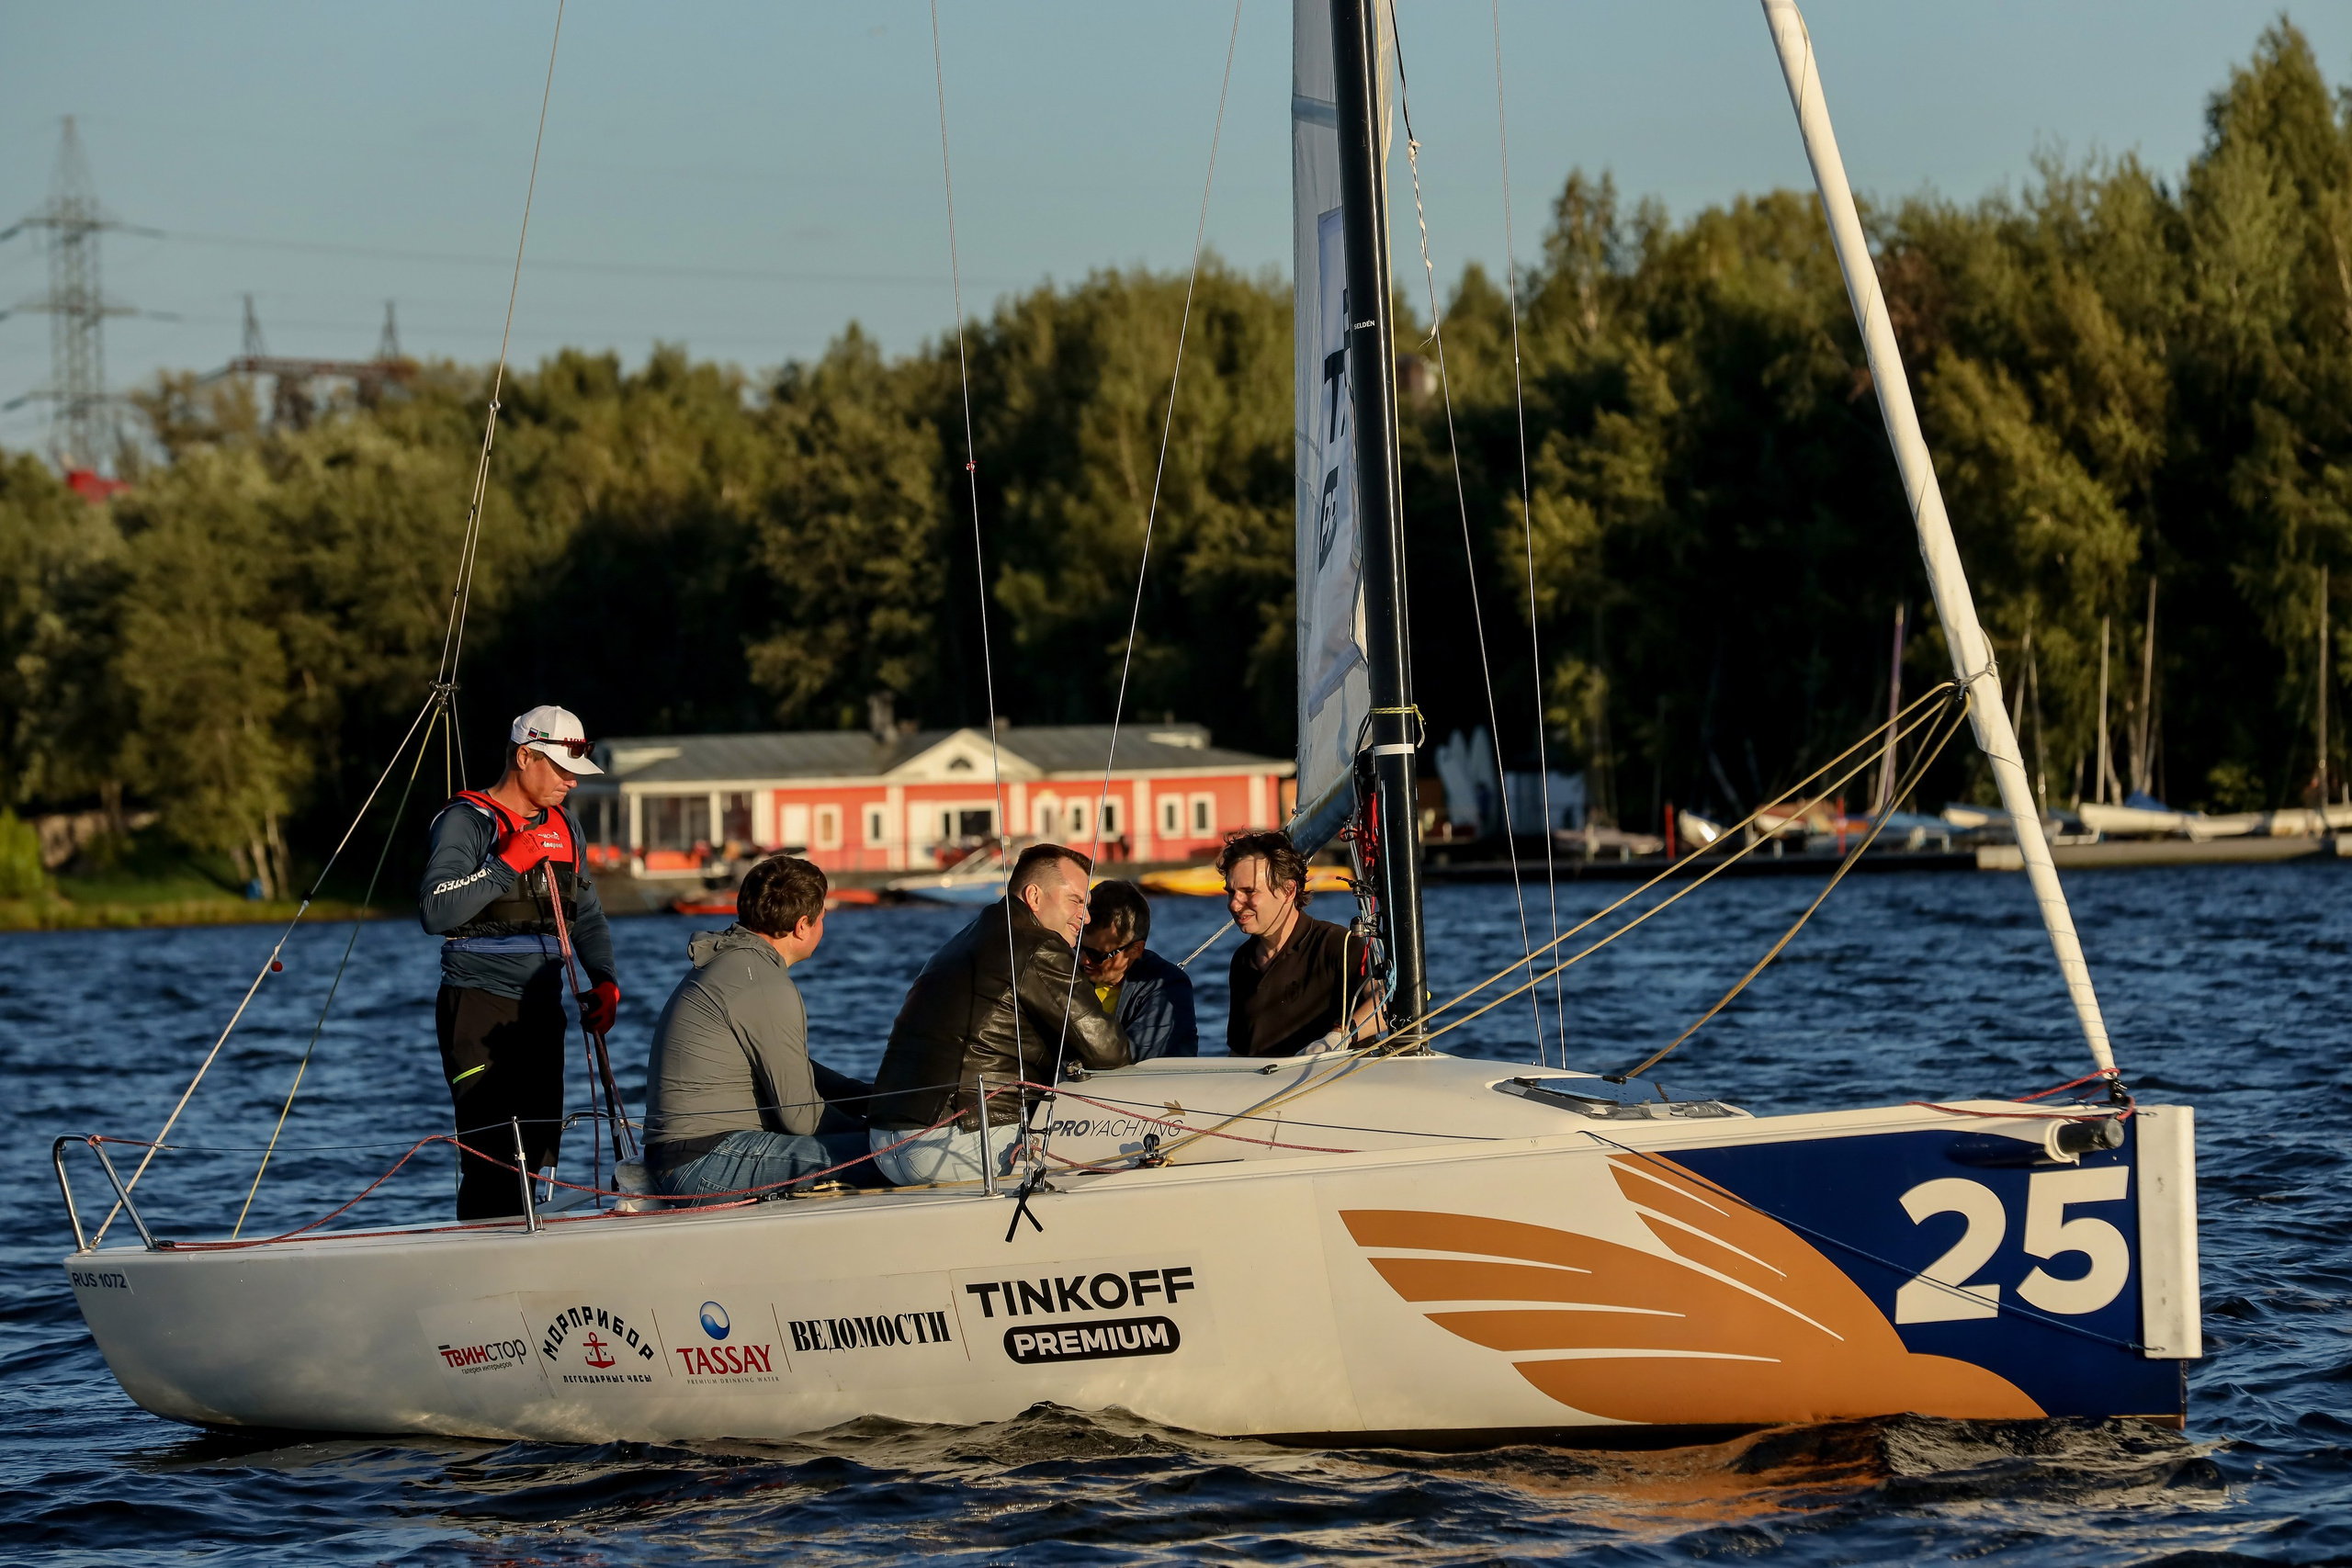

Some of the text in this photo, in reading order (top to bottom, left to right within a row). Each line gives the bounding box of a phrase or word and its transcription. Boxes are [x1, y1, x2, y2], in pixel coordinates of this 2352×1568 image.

[1049, 1119, 1184, 1137] PROYACHTING
[1894, 1166, 2130, 1325] 25
[72, 1272, 127, 1288] RUS 1072
[966, 1267, 1195, 1318] TINKOFF
[542, 1305, 654, 1362] МОРПРИБОР
[788, 1311, 952, 1354] ВЕДОМОСТИ
[1012, 1324, 1170, 1358] PREMIUM
[675, 1344, 773, 1375] TASSAY
[563, 1374, 652, 1383] ЛЕГЕНДАРНЫЕ ЧАСЫ
